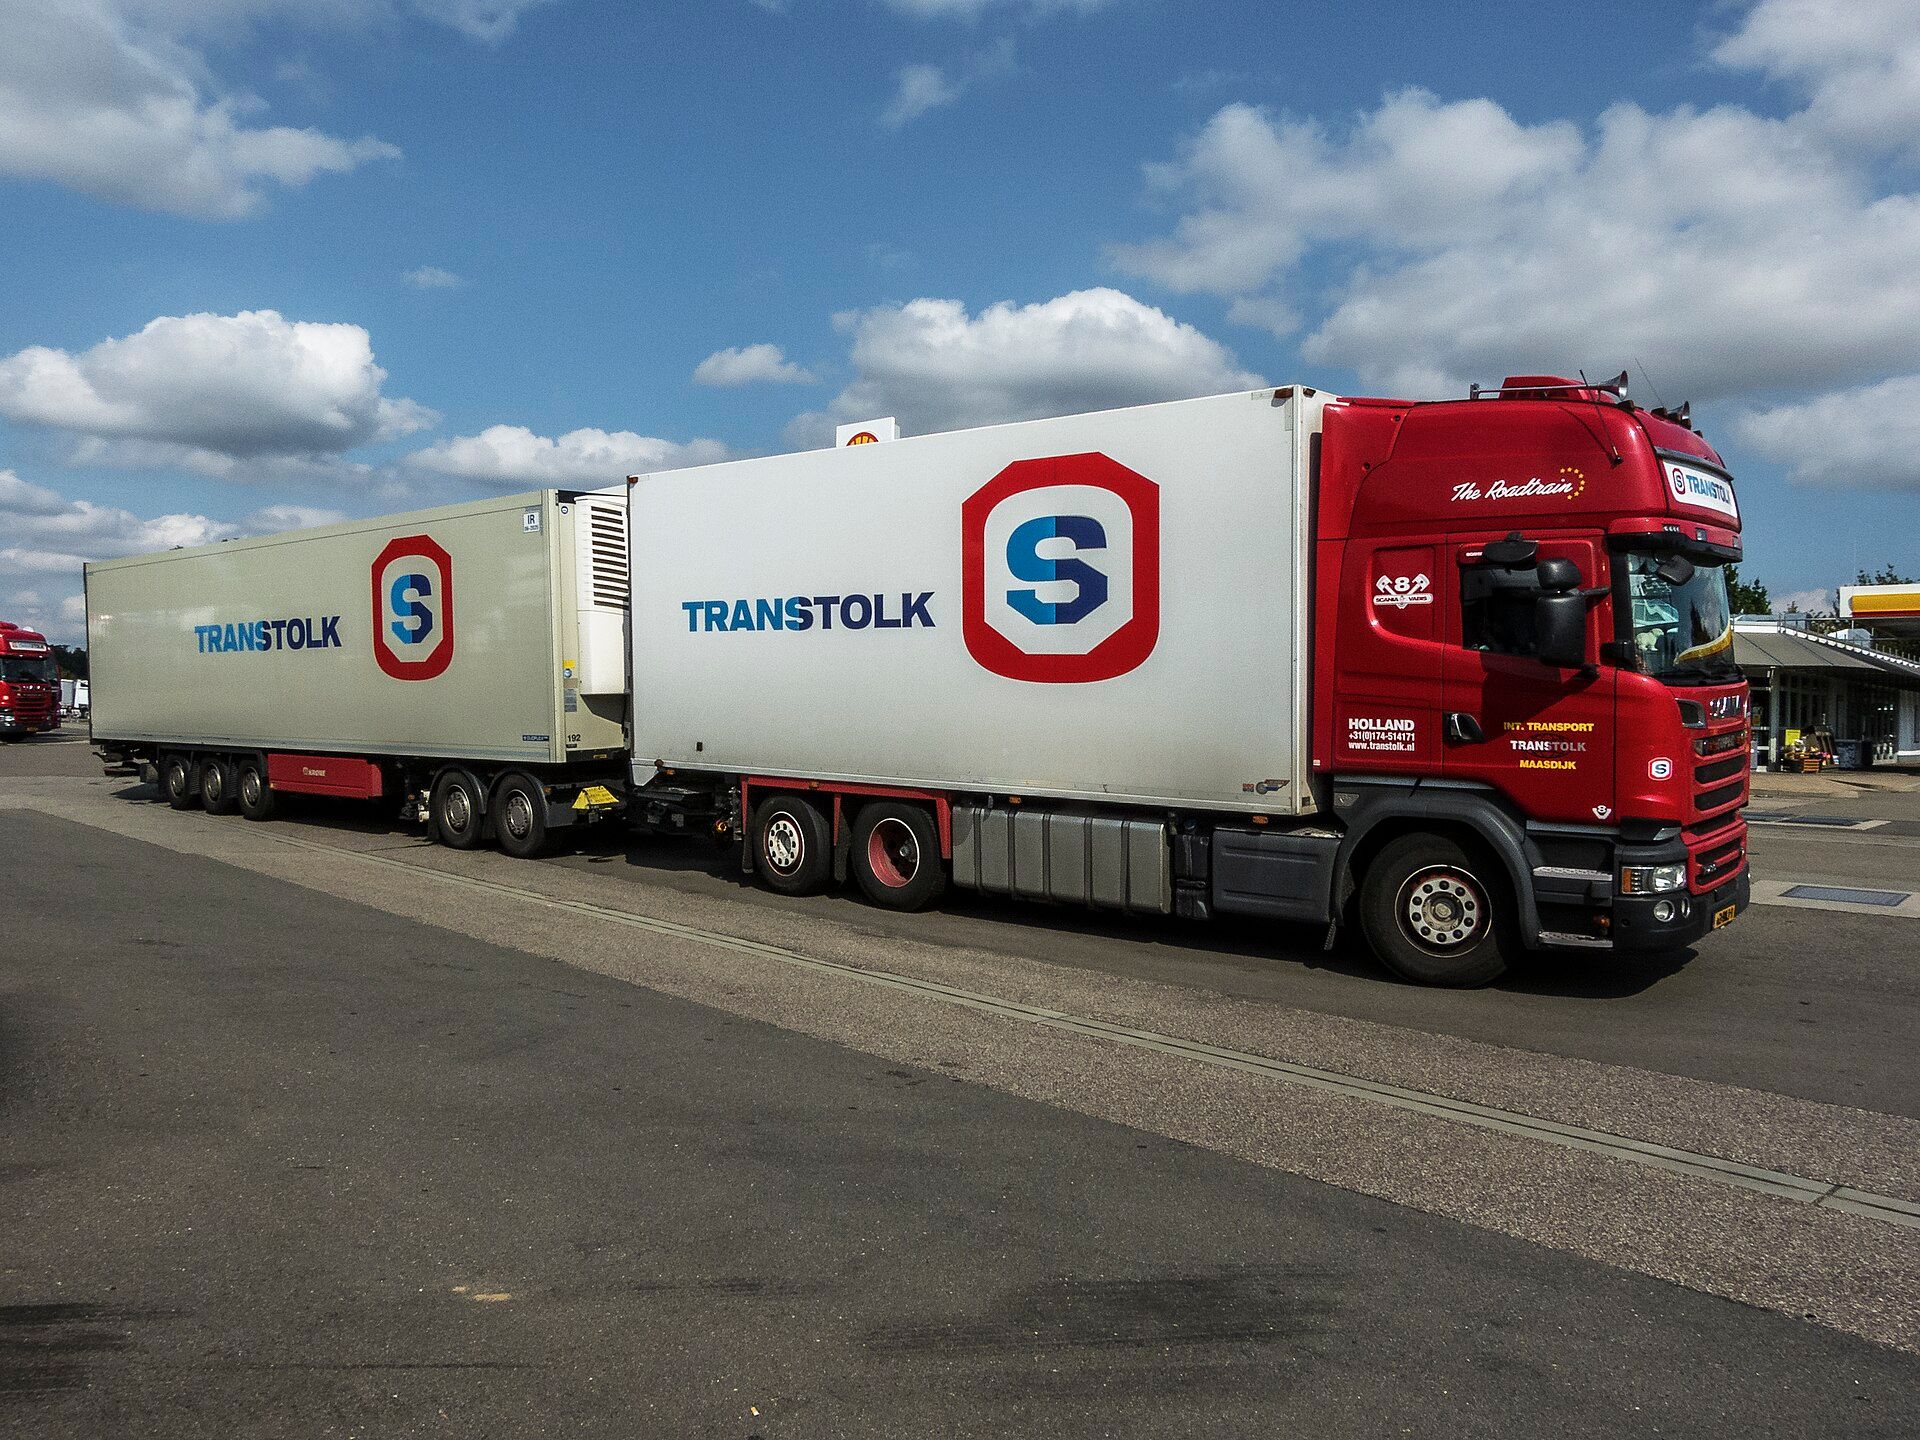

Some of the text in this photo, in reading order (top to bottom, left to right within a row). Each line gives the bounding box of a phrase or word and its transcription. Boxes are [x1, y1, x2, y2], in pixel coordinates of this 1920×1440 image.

[1451, 477, 1573, 501] The Roadtrain
[1685, 474, 1731, 505] TRANSTOL
[527, 514, 535, 524] IR
[682, 591, 936, 632] TRANSTOLK
[194, 615, 342, 654] TRANSTOLK
[1348, 718, 1415, 731] HOLLAND
[1503, 722, 1594, 732] INT. TRANSPORT
[568, 734, 581, 742] 192
[1348, 731, 1416, 742] +31(0)174-514171
[1348, 741, 1415, 752] www.transtolk.nl
[1510, 740, 1586, 752] TRANSTOLK
[1519, 759, 1577, 770] MAASDIJK
